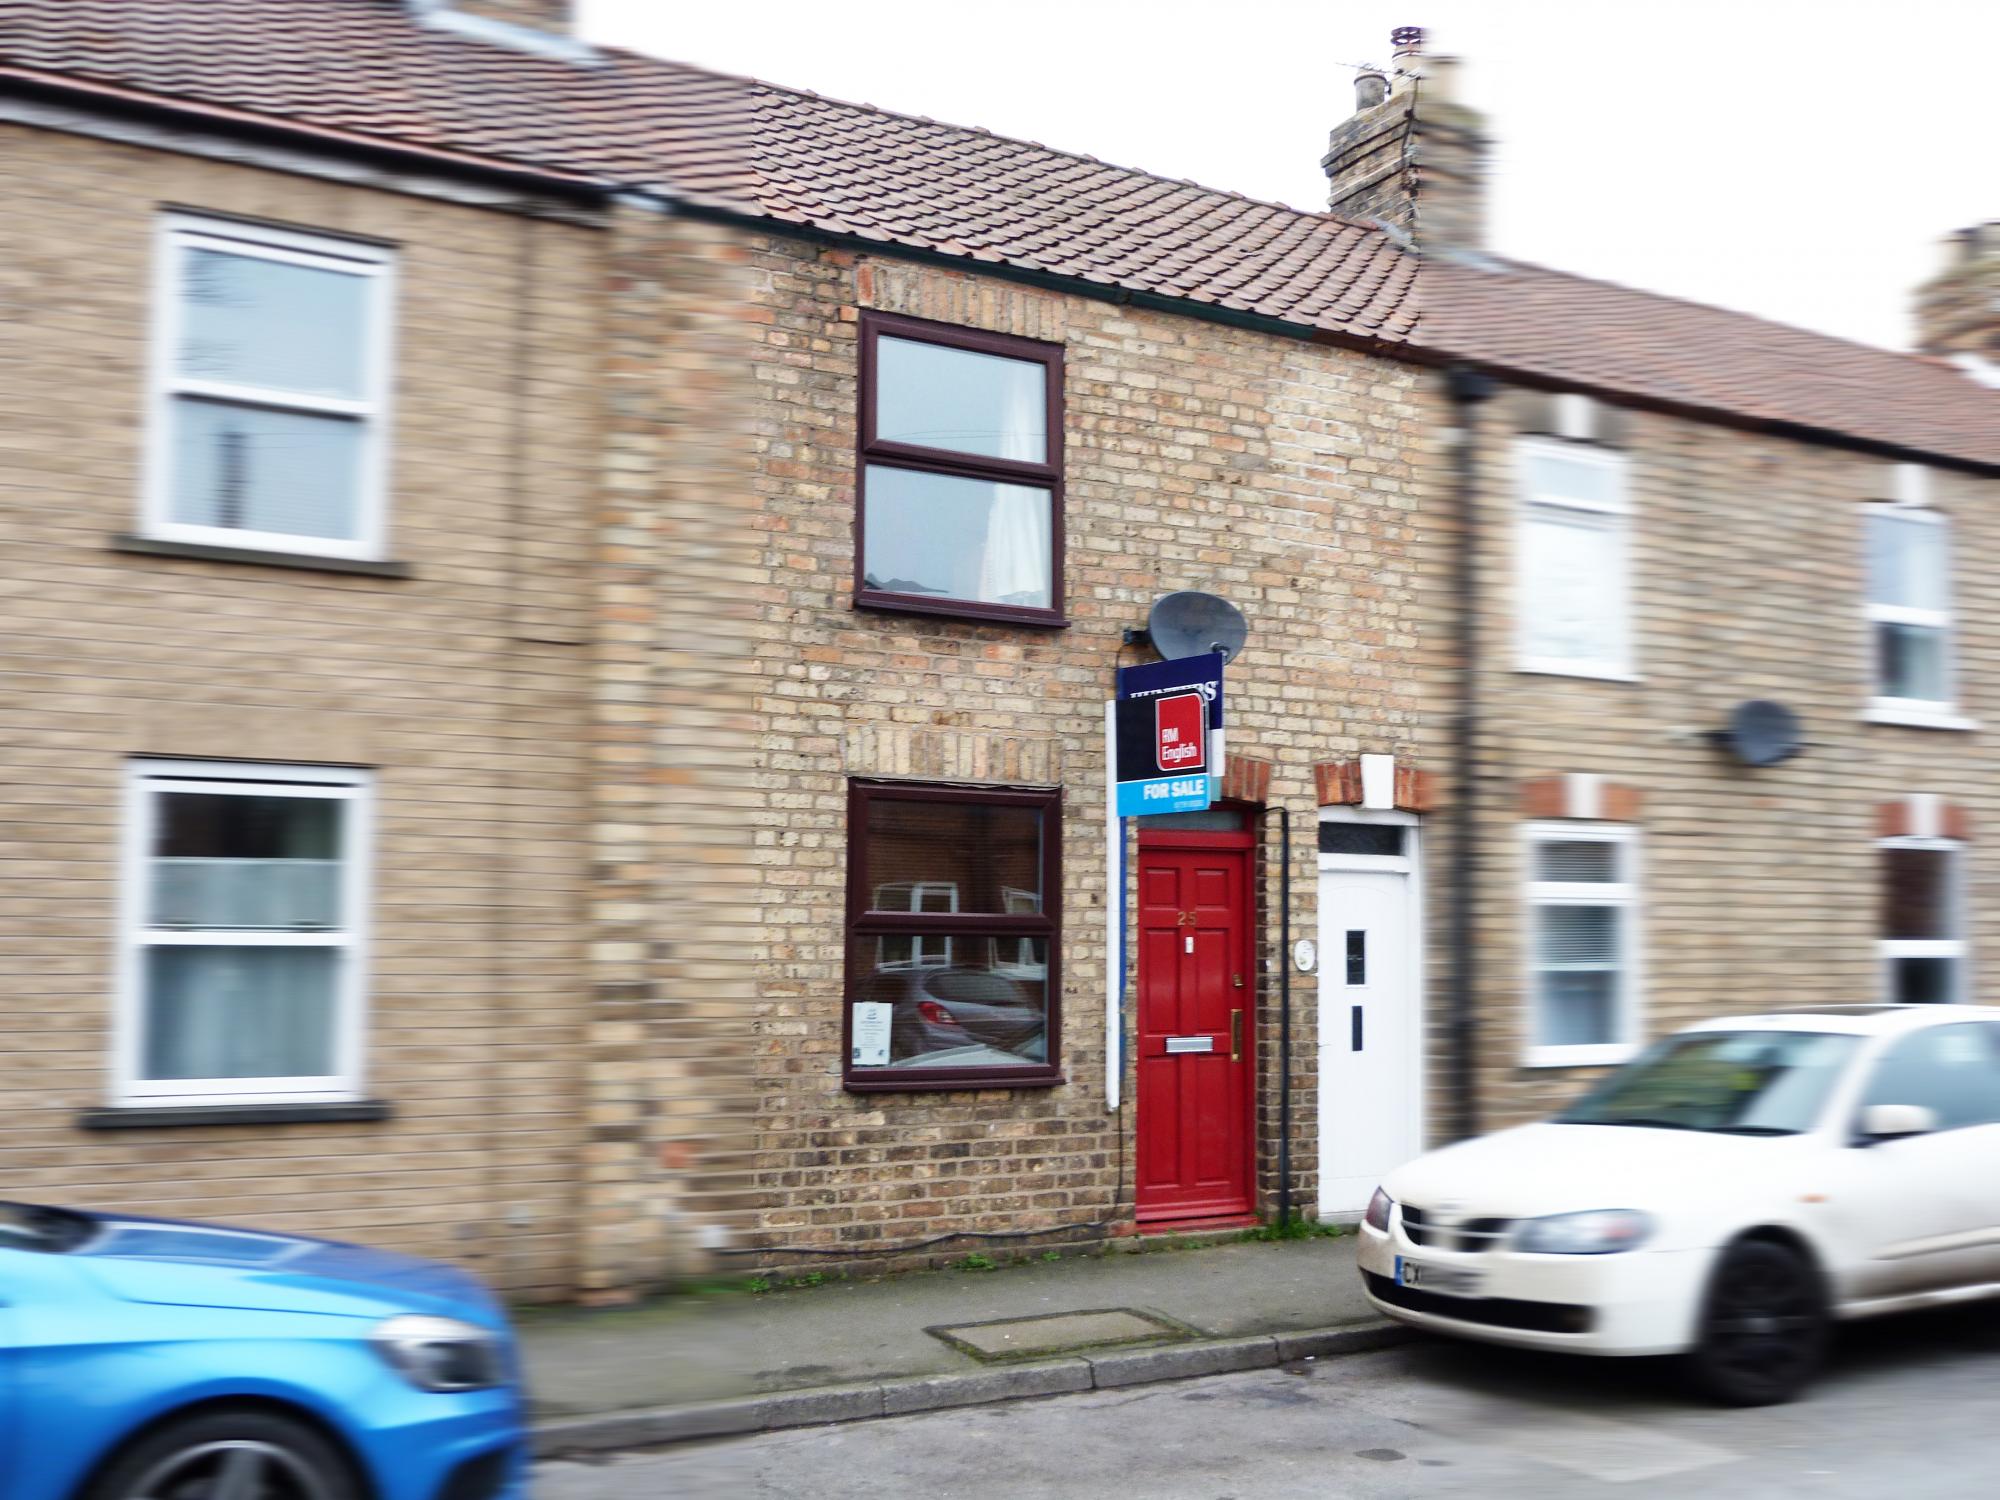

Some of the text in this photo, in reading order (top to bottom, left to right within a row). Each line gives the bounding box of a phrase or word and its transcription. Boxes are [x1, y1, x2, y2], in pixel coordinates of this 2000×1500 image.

[1161, 727, 1179, 743] RM
[1161, 742, 1198, 763] English
[1143, 779, 1205, 800] FOR SALE
[1177, 911, 1197, 926] 25
